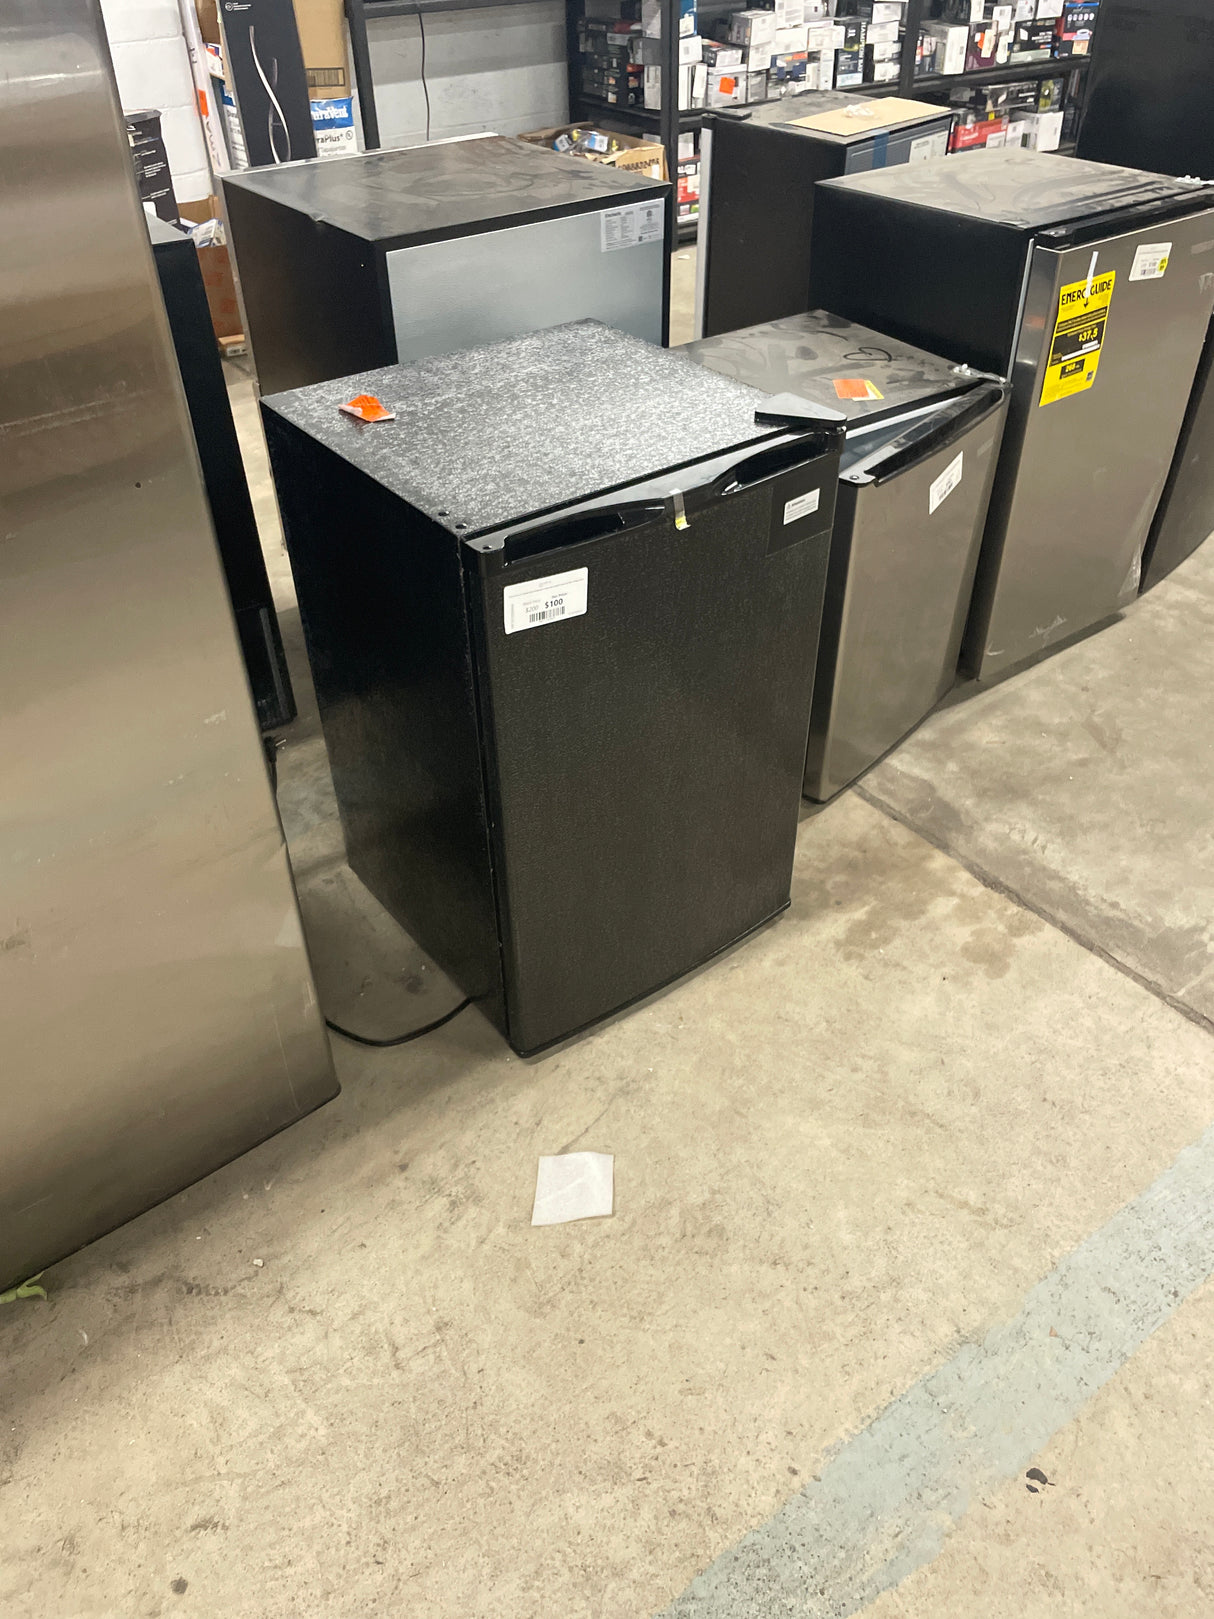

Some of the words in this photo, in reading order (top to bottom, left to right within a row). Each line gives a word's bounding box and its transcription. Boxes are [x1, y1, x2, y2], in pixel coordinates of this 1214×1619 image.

[311, 105, 349, 121] uraVent
[1061, 279, 1112, 305] ENERGGUIDE
[544, 598, 564, 609] $100
